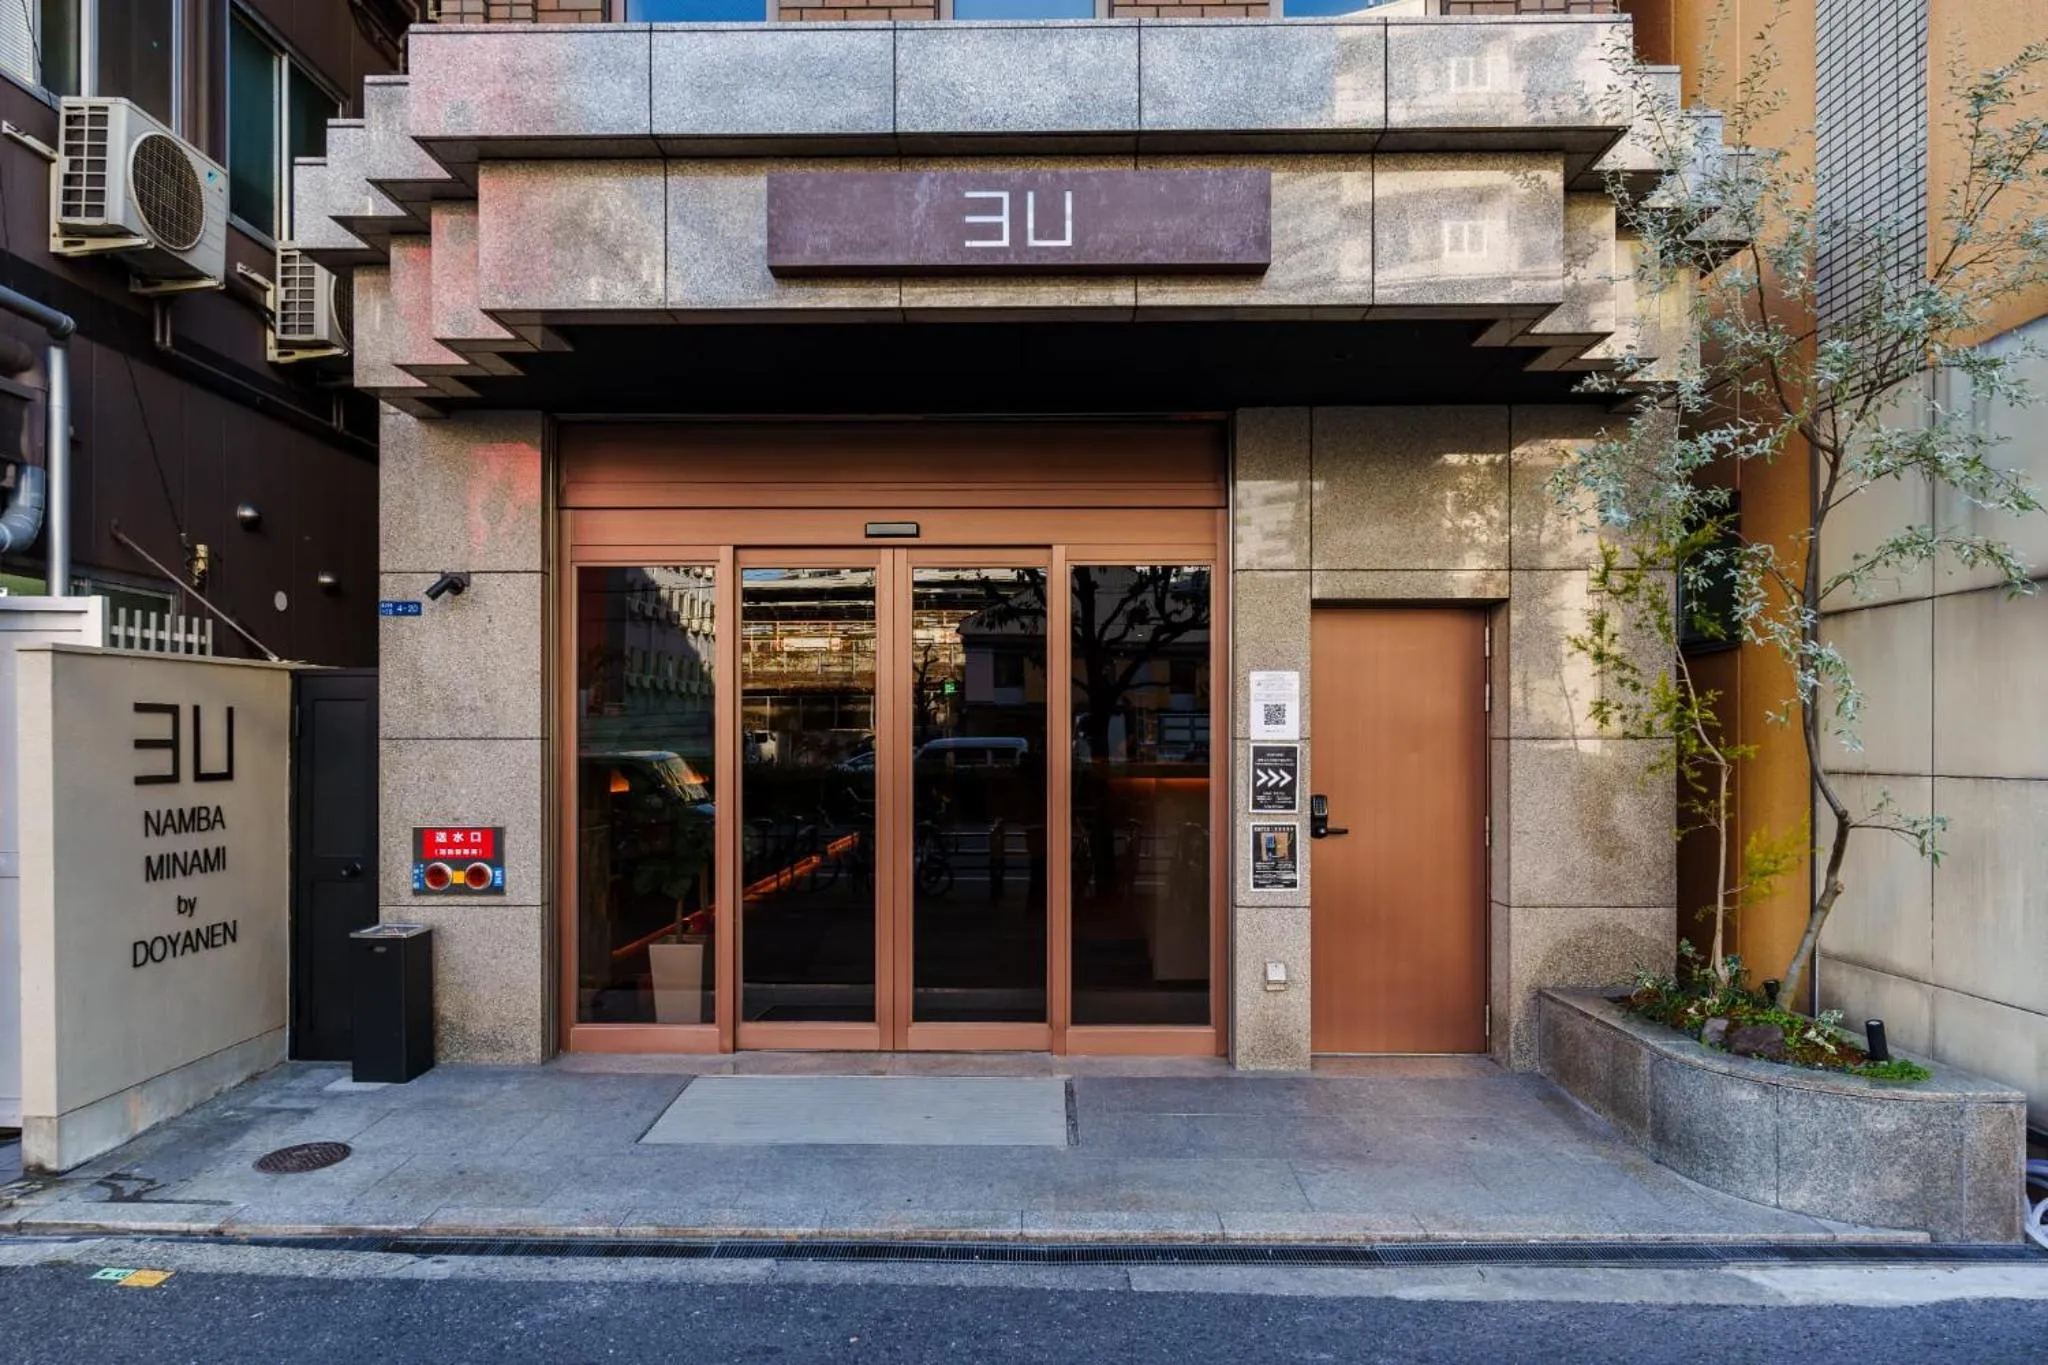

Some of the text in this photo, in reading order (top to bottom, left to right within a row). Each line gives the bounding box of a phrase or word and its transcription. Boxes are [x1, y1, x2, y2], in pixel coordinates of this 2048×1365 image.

[144, 805, 226, 838] NAMBA
[145, 846, 227, 882] MINAMI
[176, 895, 197, 917] by
[132, 920, 237, 968] DOYANEN
